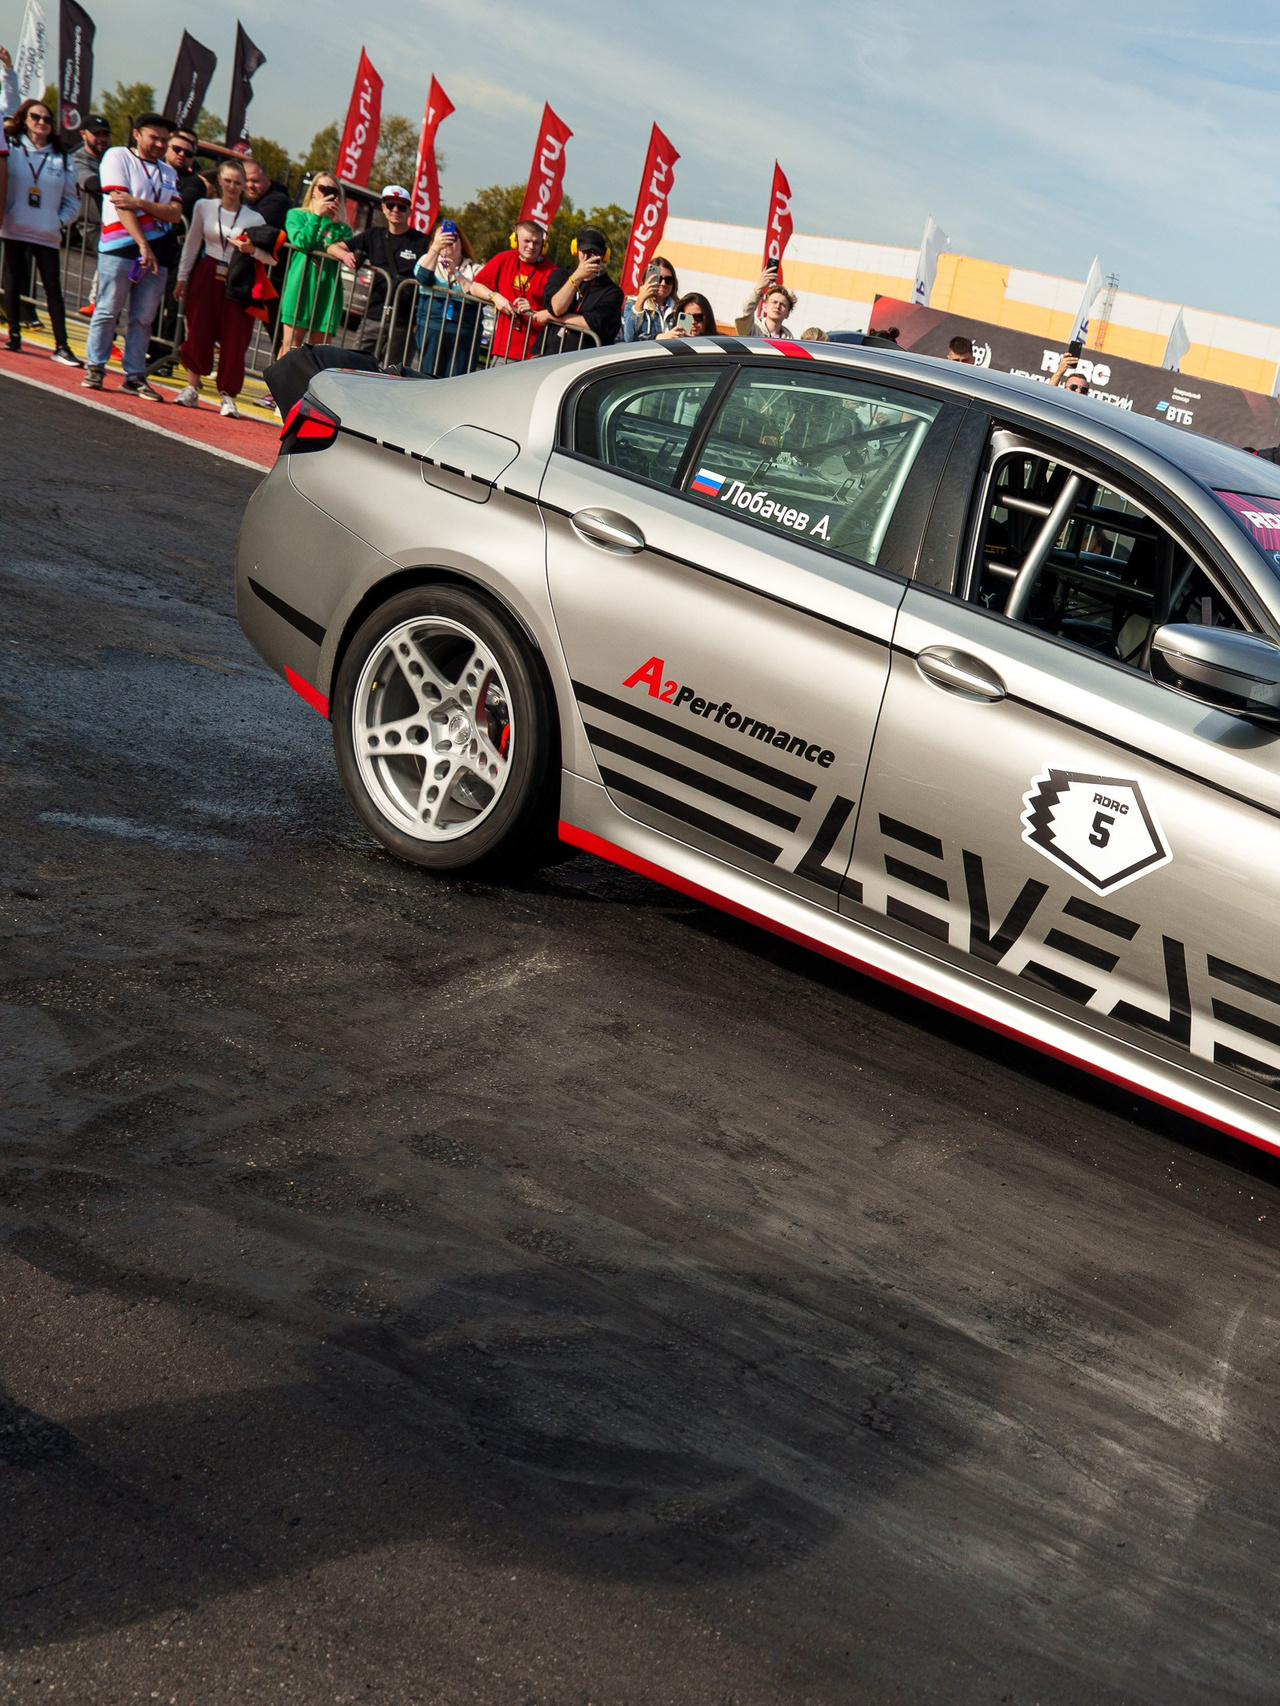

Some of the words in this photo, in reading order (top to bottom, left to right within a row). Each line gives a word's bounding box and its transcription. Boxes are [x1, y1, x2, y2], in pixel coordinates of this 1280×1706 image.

[768, 190, 791, 260] o.ru
[1041, 349, 1112, 387] RRC
[1165, 405, 1194, 426] ВТБ
[720, 480, 811, 532] Лобачев
[809, 514, 831, 541] А.
[1092, 792, 1130, 815] RDRC
[1088, 811, 1116, 849] 5
